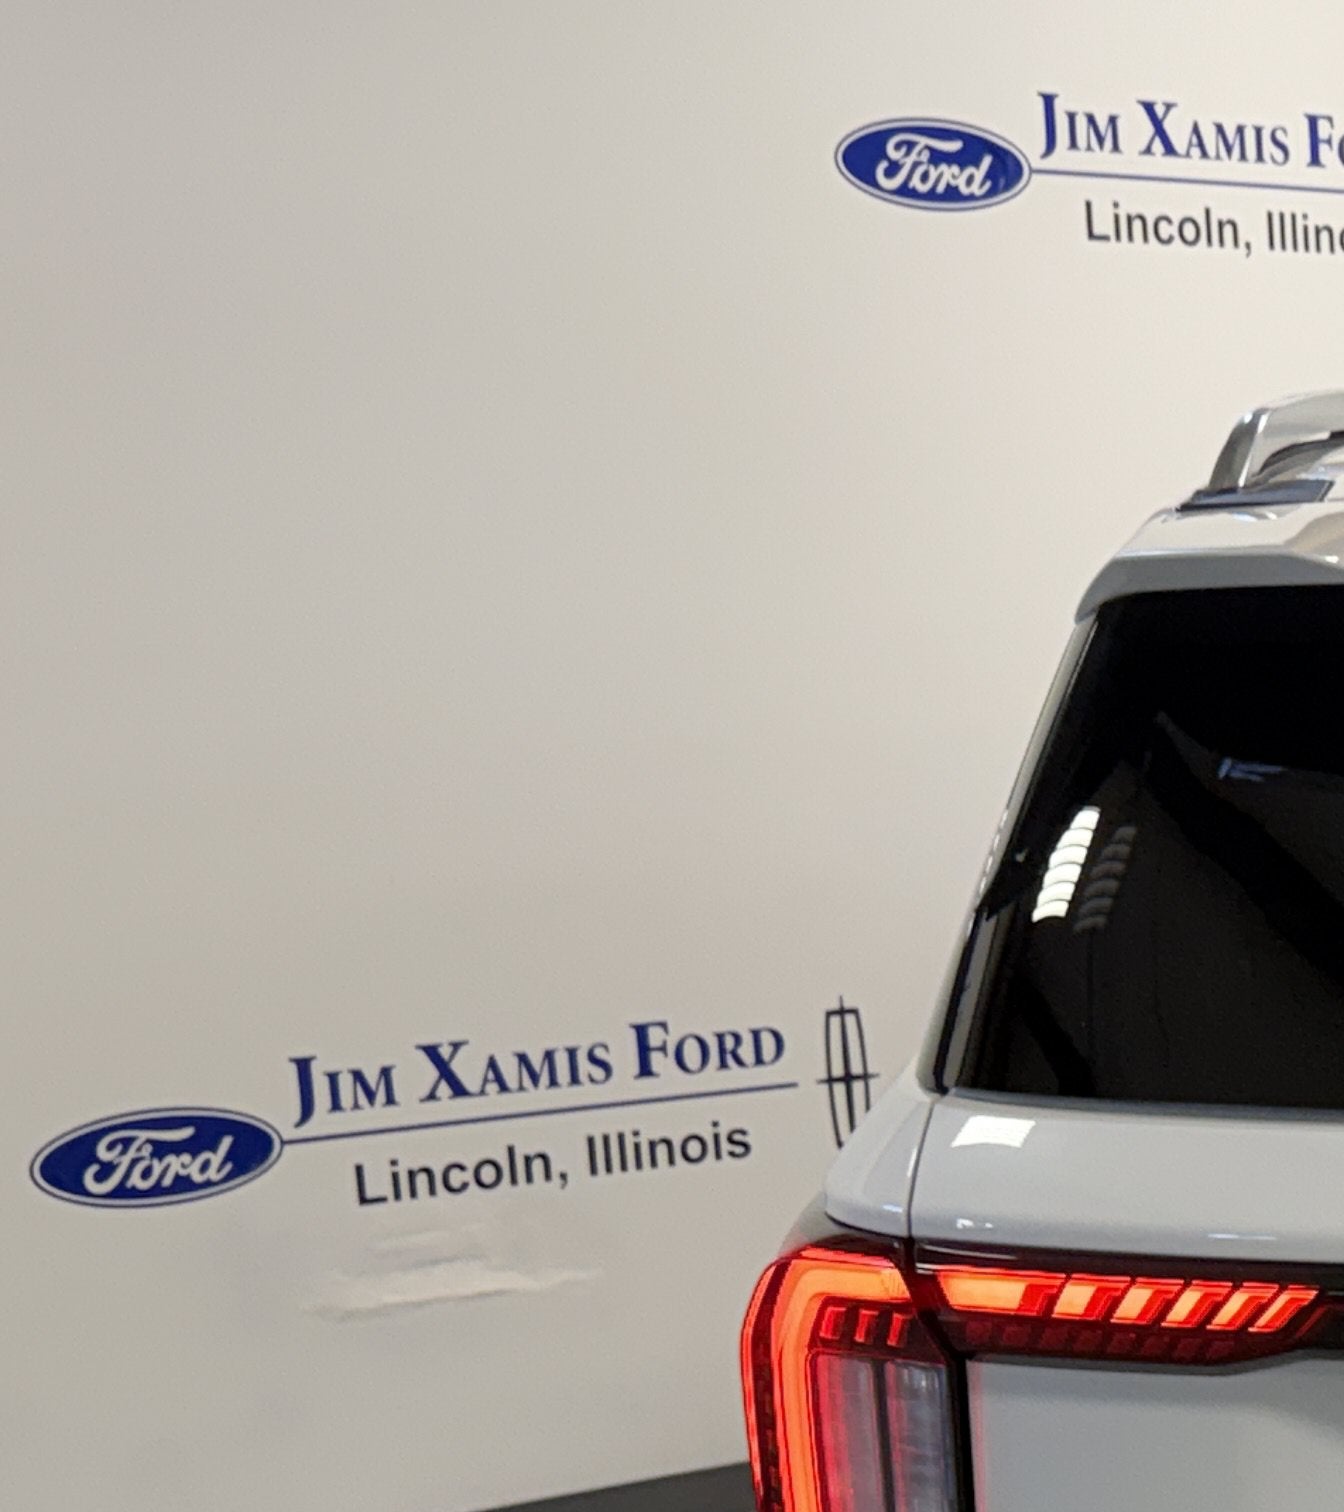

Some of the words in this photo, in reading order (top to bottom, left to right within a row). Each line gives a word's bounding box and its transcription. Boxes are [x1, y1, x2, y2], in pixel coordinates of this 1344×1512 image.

[875, 132, 992, 198] Ford
[1037, 92, 1123, 160] JIM
[1136, 99, 1290, 167] XAMIS
[1086, 201, 1252, 257] Lincoln,
[289, 1055, 396, 1128] JIM
[415, 1040, 613, 1103] XAMIS
[629, 1020, 786, 1080] FORD
[83, 1126, 233, 1196] Ford
[355, 1145, 568, 1206] Lincoln,
[588, 1123, 752, 1177] Illinois
